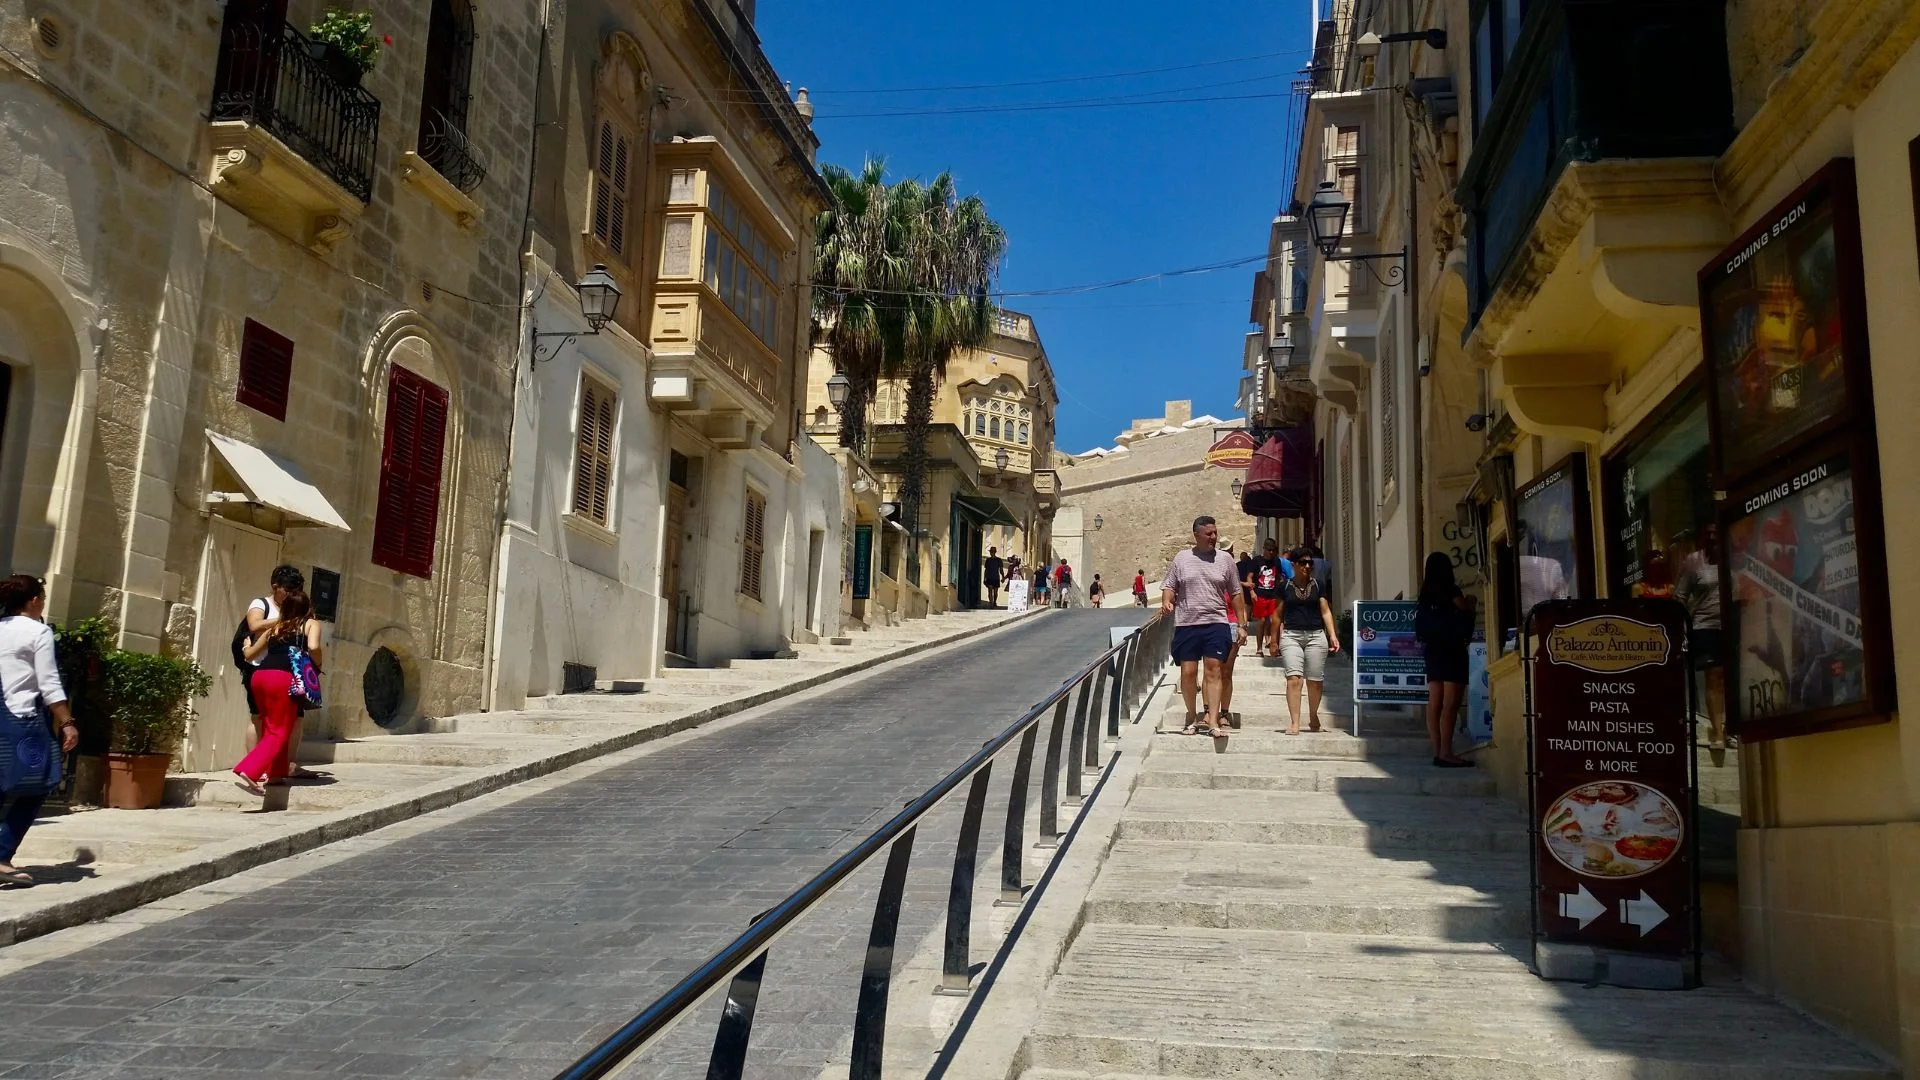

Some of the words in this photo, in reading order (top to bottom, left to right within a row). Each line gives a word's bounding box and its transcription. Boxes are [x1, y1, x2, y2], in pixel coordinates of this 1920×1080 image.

[1726, 231, 1769, 274] COMING
[1772, 202, 1806, 237] SOON
[1524, 480, 1545, 499] COMING
[1545, 470, 1562, 486] SOON
[1745, 483, 1789, 514] COMING
[1793, 463, 1828, 491] SOON
[1620, 519, 1643, 542] VALLETTA
[1824, 540, 1857, 562] SATURDA
[1746, 558, 1794, 602] CHILDREN
[1795, 591, 1841, 631] CINEMA
[1845, 617, 1862, 640] DA
[1362, 610, 1399, 622] GOZO
[1553, 636, 1605, 652] Palazzo
[1607, 636, 1663, 652] Antonin
[1583, 682, 1635, 694] SNACKS
[1590, 701, 1630, 714] PASTA
[1567, 720, 1600, 732] MAIN
[1606, 721, 1654, 734] DISHES
[1547, 738, 1633, 753] TRADITIONAL
[1637, 742, 1675, 755] FOOD
[1585, 759, 1594, 771] &
[1600, 760, 1638, 773] MORE
